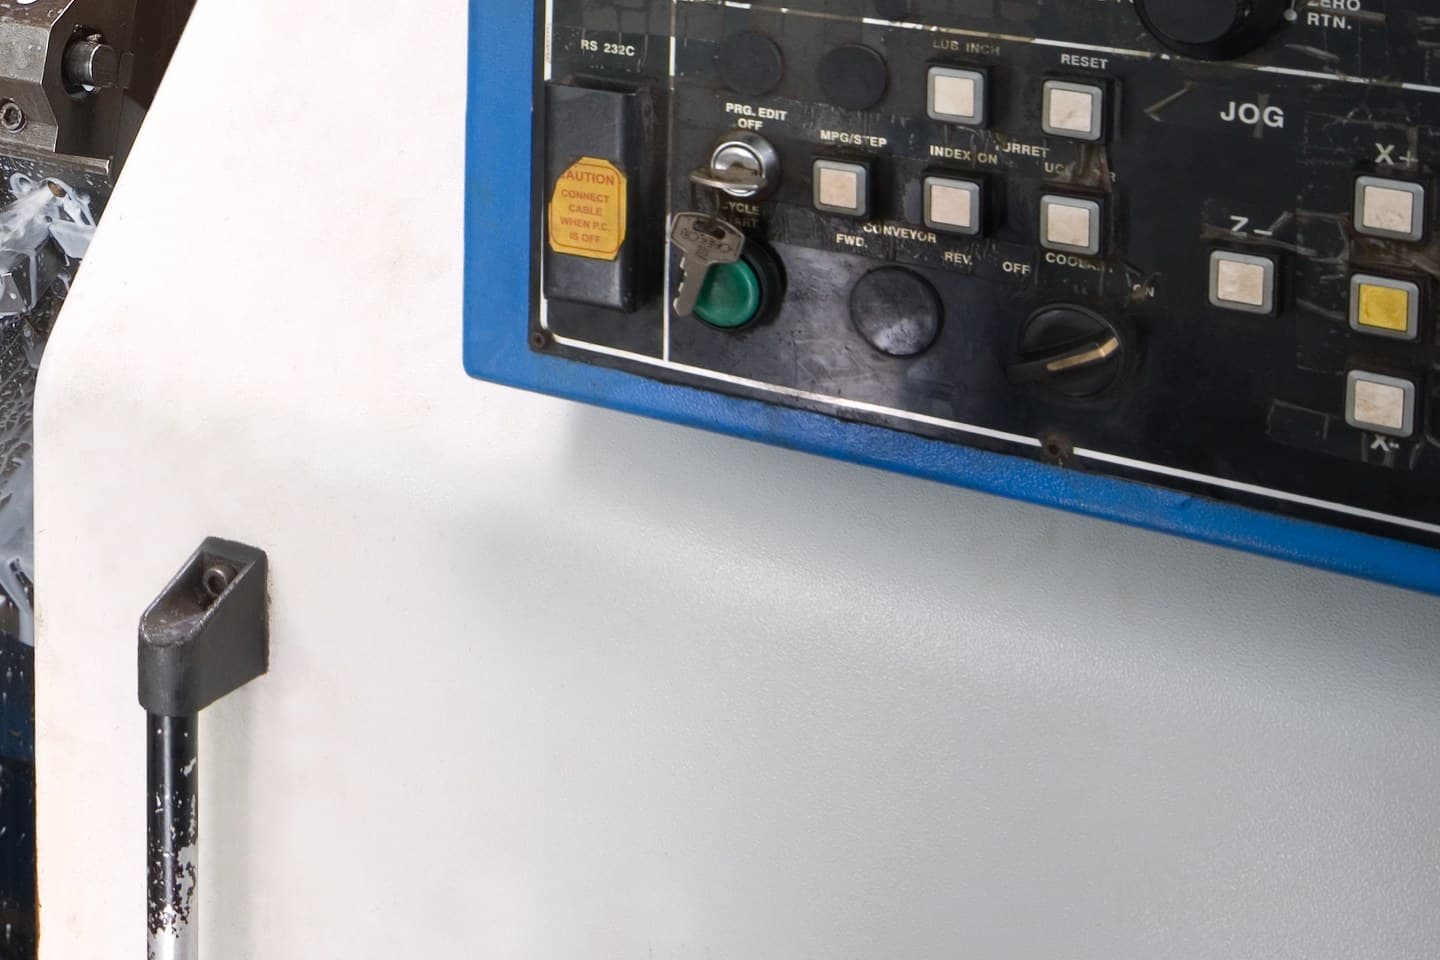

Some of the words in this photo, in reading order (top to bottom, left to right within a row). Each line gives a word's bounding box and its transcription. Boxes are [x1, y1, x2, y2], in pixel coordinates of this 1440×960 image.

[1307, 12, 1352, 30] RTN.
[580, 39, 598, 52] RS
[603, 42, 636, 56] 232C
[966, 42, 1000, 56] INCH
[1061, 53, 1109, 70] RESET
[725, 102, 756, 117] PRG.
[758, 106, 788, 121] EDIT
[1220, 100, 1285, 128] JOG
[737, 117, 763, 130] OFF
[820, 130, 887, 147] MPG/STEP
[929, 145, 971, 161] INDEX
[978, 150, 998, 165] ON
[995, 142, 1050, 158] URRET
[561, 170, 615, 185] AUTION
[561, 189, 610, 203] CONNECT
[568, 204, 602, 216] CABLE
[721, 201, 760, 215] YCLE
[560, 216, 590, 228] WHEN
[569, 232, 578, 241] IS
[581, 233, 601, 242] OFF
[836, 234, 868, 249] FWD.
[944, 250, 973, 266] REV.
[1002, 261, 1031, 276] OFF
